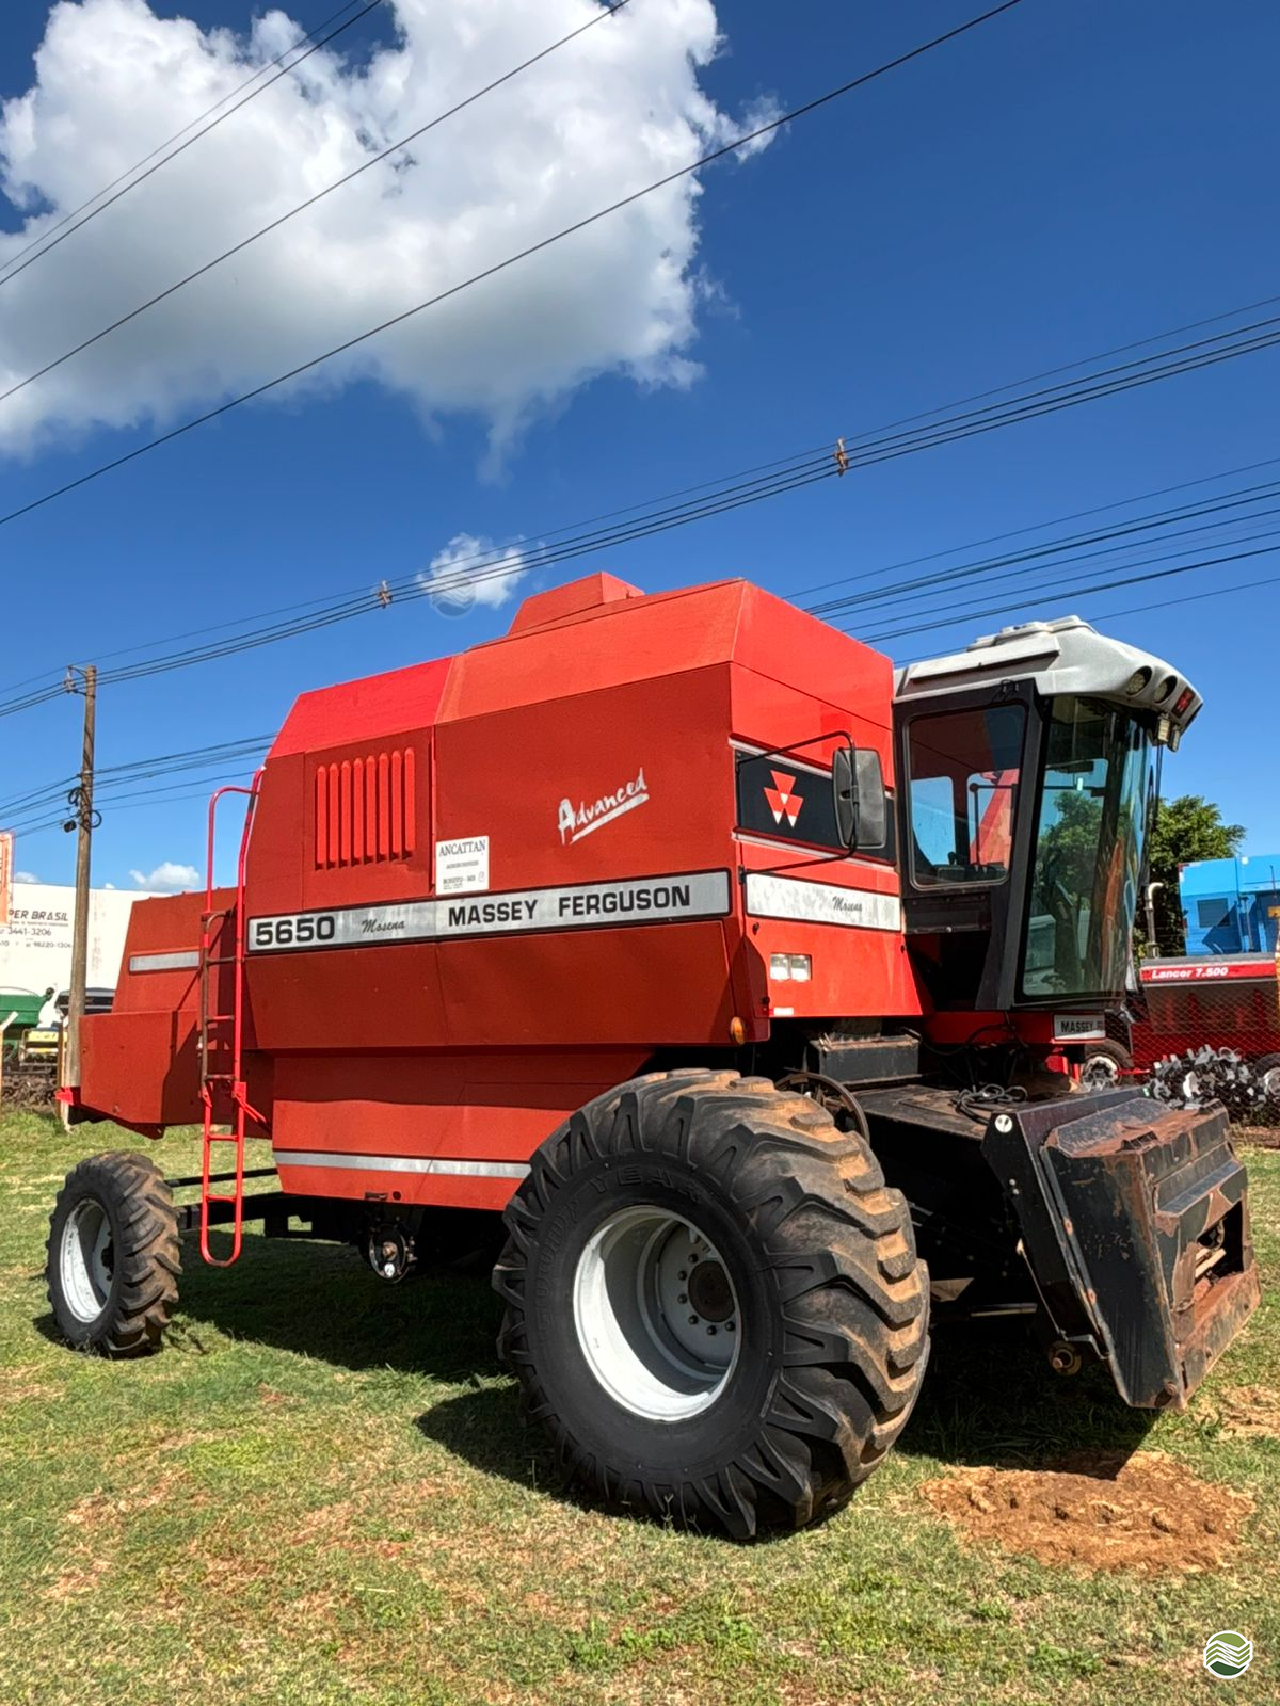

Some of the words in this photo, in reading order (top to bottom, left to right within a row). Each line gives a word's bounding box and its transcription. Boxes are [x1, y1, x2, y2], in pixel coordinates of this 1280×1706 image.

[558, 767, 648, 845] Advanced
[31, 910, 68, 921] BRASIL
[255, 916, 335, 946] 5650
[448, 899, 538, 927] MASSEY
[558, 885, 691, 917] FERGUSON
[1060, 1020, 1093, 1032] MASSEY
